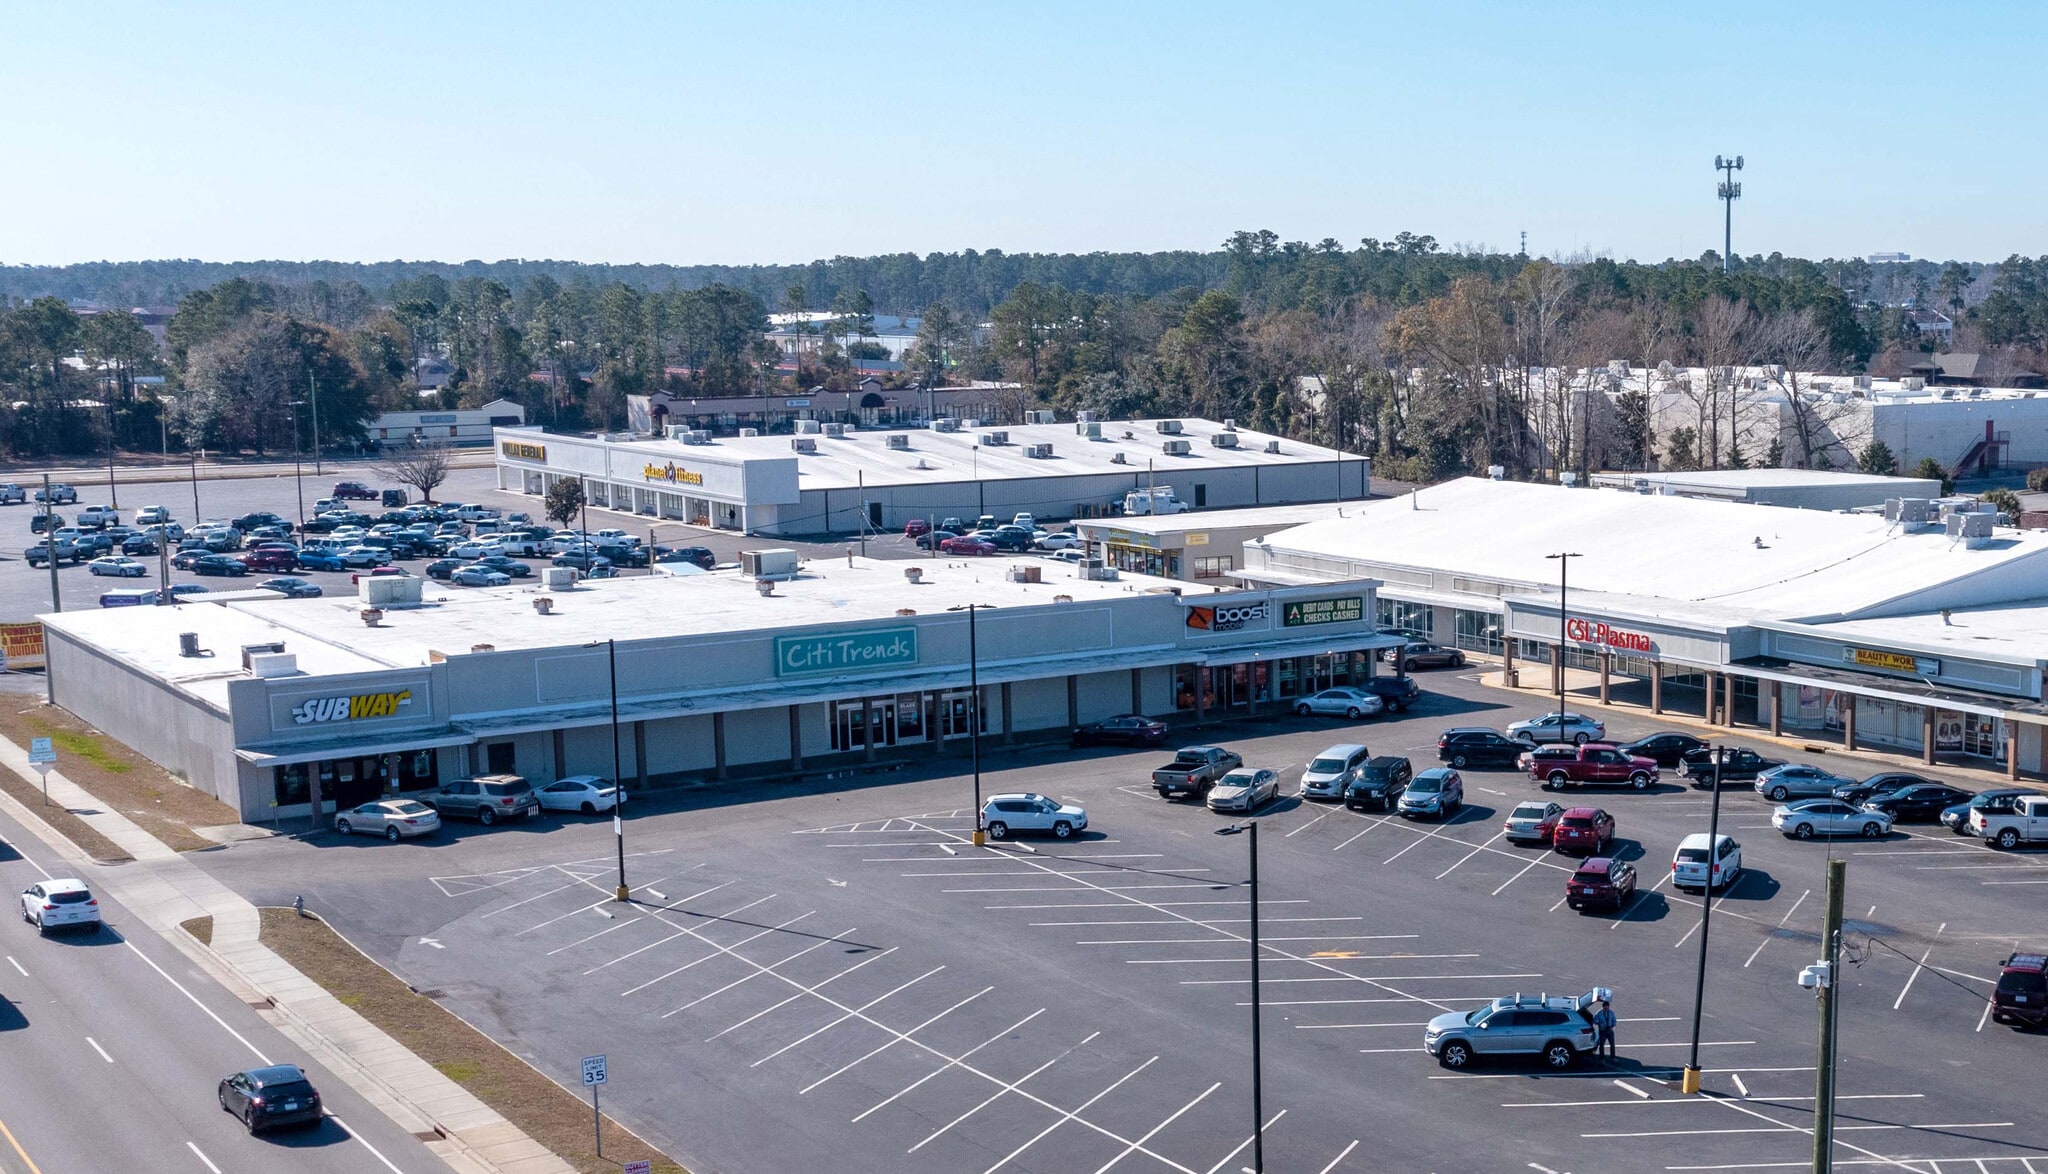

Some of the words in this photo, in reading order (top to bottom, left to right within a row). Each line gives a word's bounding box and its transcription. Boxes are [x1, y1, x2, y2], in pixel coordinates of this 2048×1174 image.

[1216, 602, 1269, 622] boost
[1303, 602, 1317, 613] DEBIT
[1317, 601, 1334, 612] CARDS
[1336, 600, 1346, 610] PAY
[1347, 599, 1361, 609] BILLS
[1303, 612, 1331, 623] CHECKS
[1332, 609, 1360, 620] CASHED
[1215, 620, 1245, 632] mobile
[1567, 618, 1593, 642] CSL
[1596, 623, 1650, 652] Plasma
[787, 642, 833, 668] Citi
[837, 636, 910, 663] Trends
[1857, 650, 1888, 661] BEAUTY
[292, 690, 411, 724] SUBWAY
[584, 1058, 604, 1066] SPEED
[585, 1070, 605, 1083] 35
